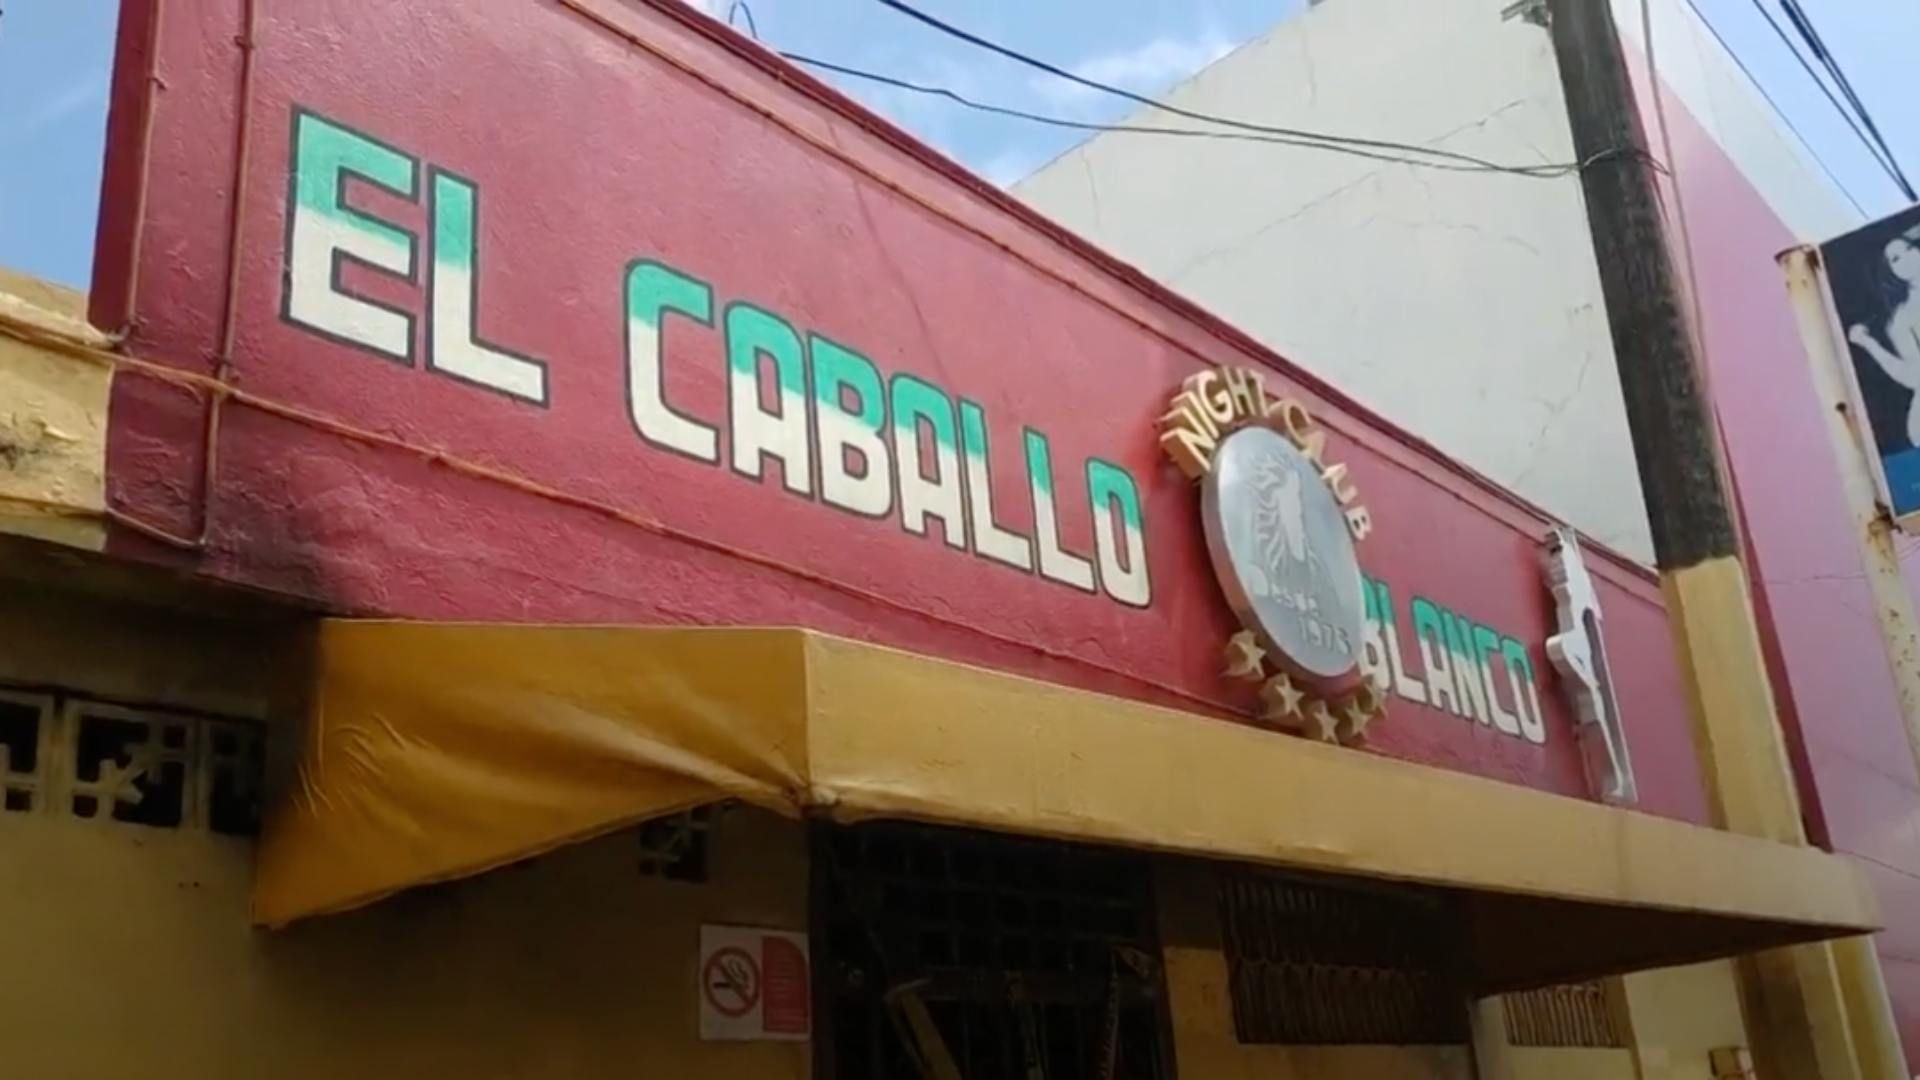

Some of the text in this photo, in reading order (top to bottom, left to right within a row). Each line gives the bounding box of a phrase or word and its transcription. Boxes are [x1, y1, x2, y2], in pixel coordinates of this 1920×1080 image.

[280, 104, 551, 409] EL
[623, 257, 1152, 609] CABALLO
[1158, 365, 1372, 541] NIGHT CLUB
